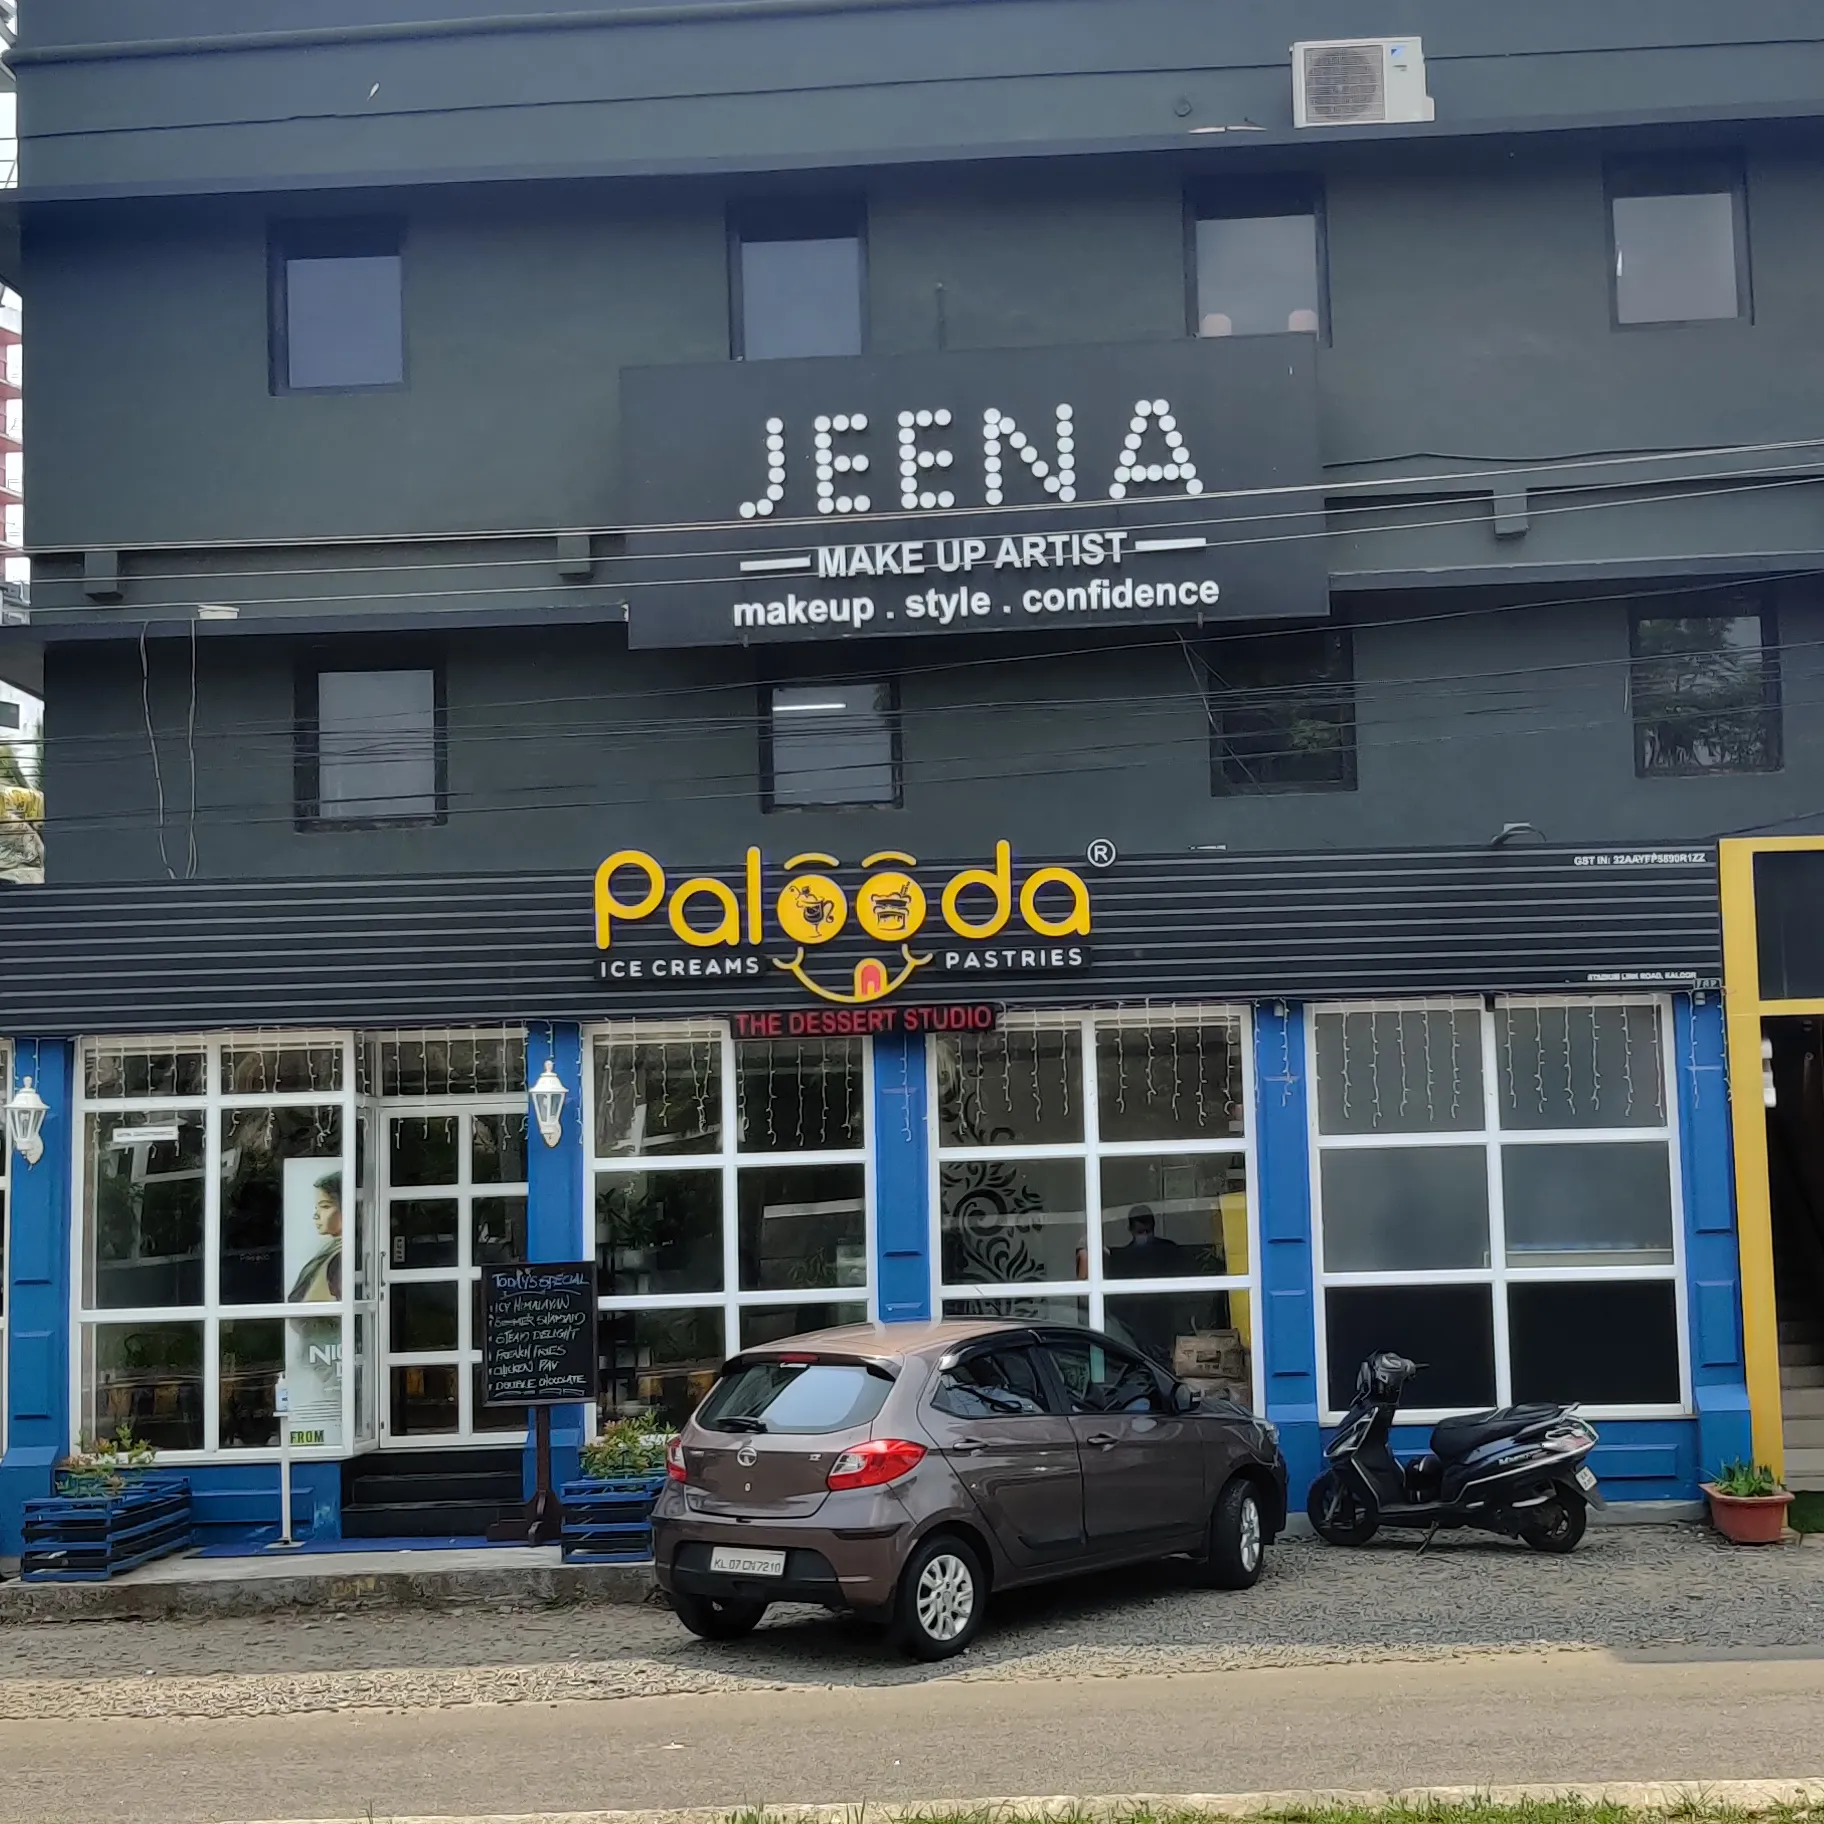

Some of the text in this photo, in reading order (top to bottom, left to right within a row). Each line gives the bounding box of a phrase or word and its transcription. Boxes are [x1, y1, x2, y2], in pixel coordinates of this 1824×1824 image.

[739, 398, 1204, 519] JEENA
[817, 531, 1128, 578] MAKE UP ARTIST
[733, 594, 875, 628] makeup
[904, 586, 992, 624] style
[1022, 577, 1220, 614] confidence
[600, 957, 761, 977] ICE CREAMS
[945, 948, 1083, 969] PASTRIES
[735, 1005, 993, 1036] THE DESSERT STUDIO
[289, 1430, 325, 1444] FROM
